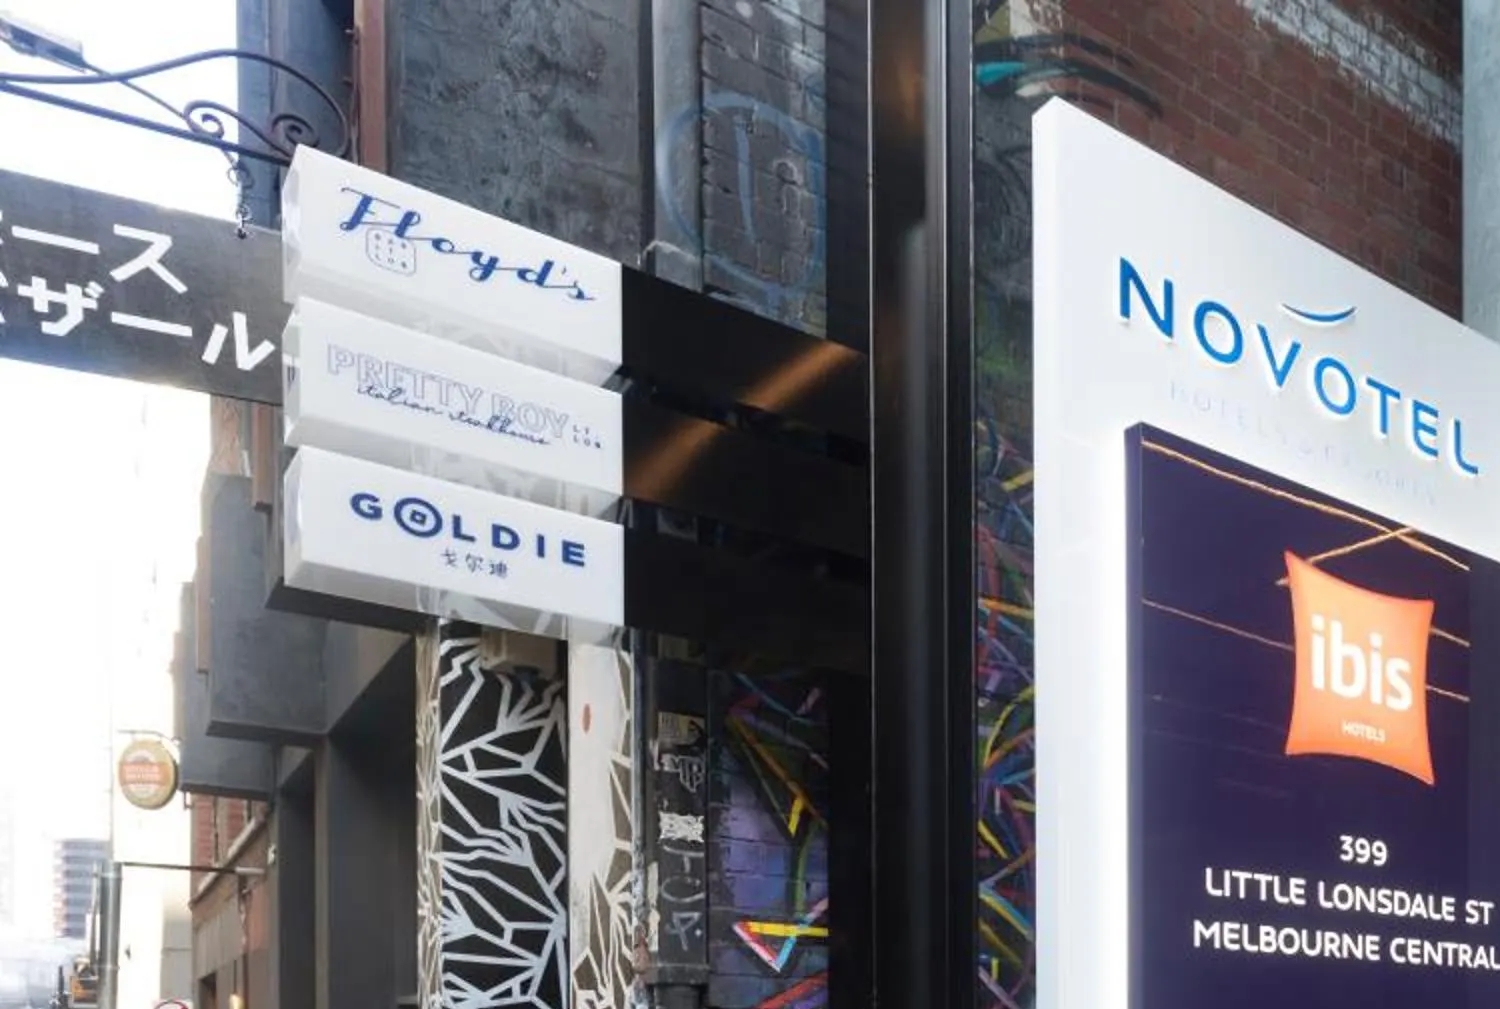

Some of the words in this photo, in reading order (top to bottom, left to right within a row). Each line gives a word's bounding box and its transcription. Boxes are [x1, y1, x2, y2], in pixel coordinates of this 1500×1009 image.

[0, 210, 188, 294] ース
[340, 187, 596, 300] Floyd's
[0, 271, 276, 371] ザール
[328, 344, 484, 417] PRETTY
[491, 393, 570, 439] BOY
[1119, 257, 1480, 475] NOVOTEL
[350, 493, 586, 568] GOLDIE
[1311, 613, 1414, 712] ibis
[1342, 720, 1386, 743] HOTELS
[1339, 834, 1388, 867] 399
[1205, 867, 1307, 906] LITTLE
[1317, 880, 1456, 922] LONSDALE
[1465, 899, 1495, 925] ST
[1193, 920, 1381, 962] MELBOURNE
